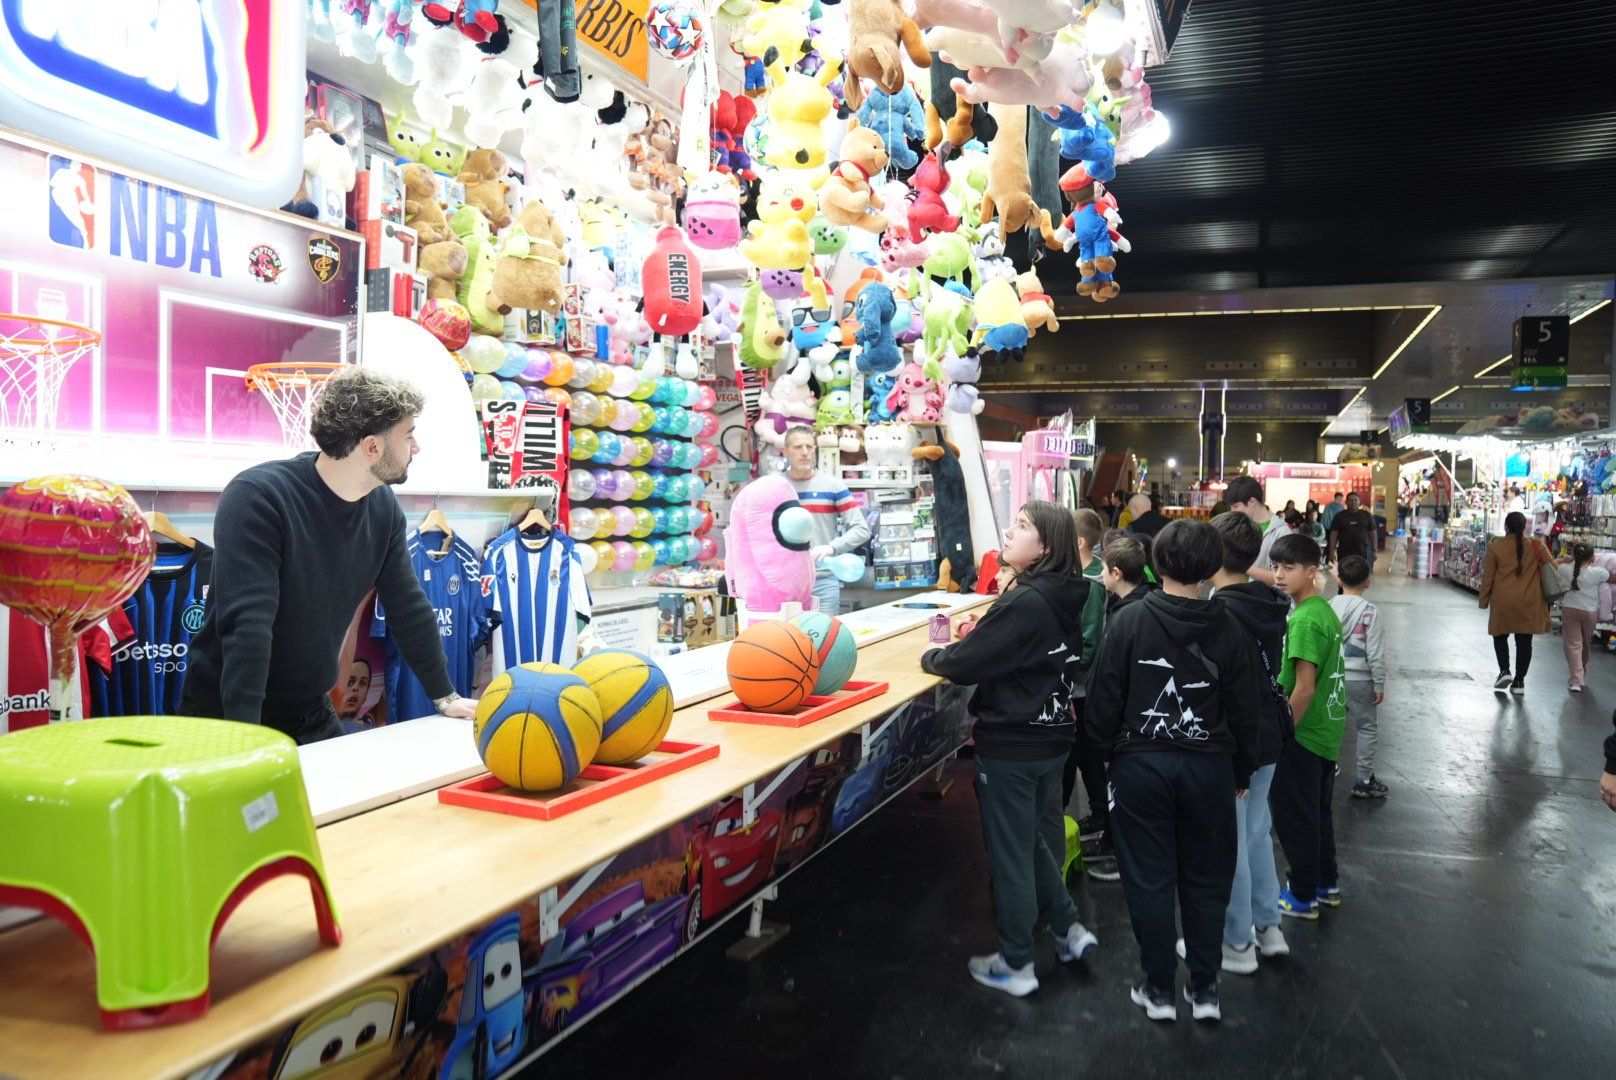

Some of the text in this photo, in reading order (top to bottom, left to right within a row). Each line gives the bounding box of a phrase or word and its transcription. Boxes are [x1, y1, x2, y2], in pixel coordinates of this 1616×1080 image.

[109, 172, 222, 279] NBA
[667, 253, 691, 303] ENERGY
[1538, 320, 1552, 343] 5
[1413, 400, 1423, 414] 5
